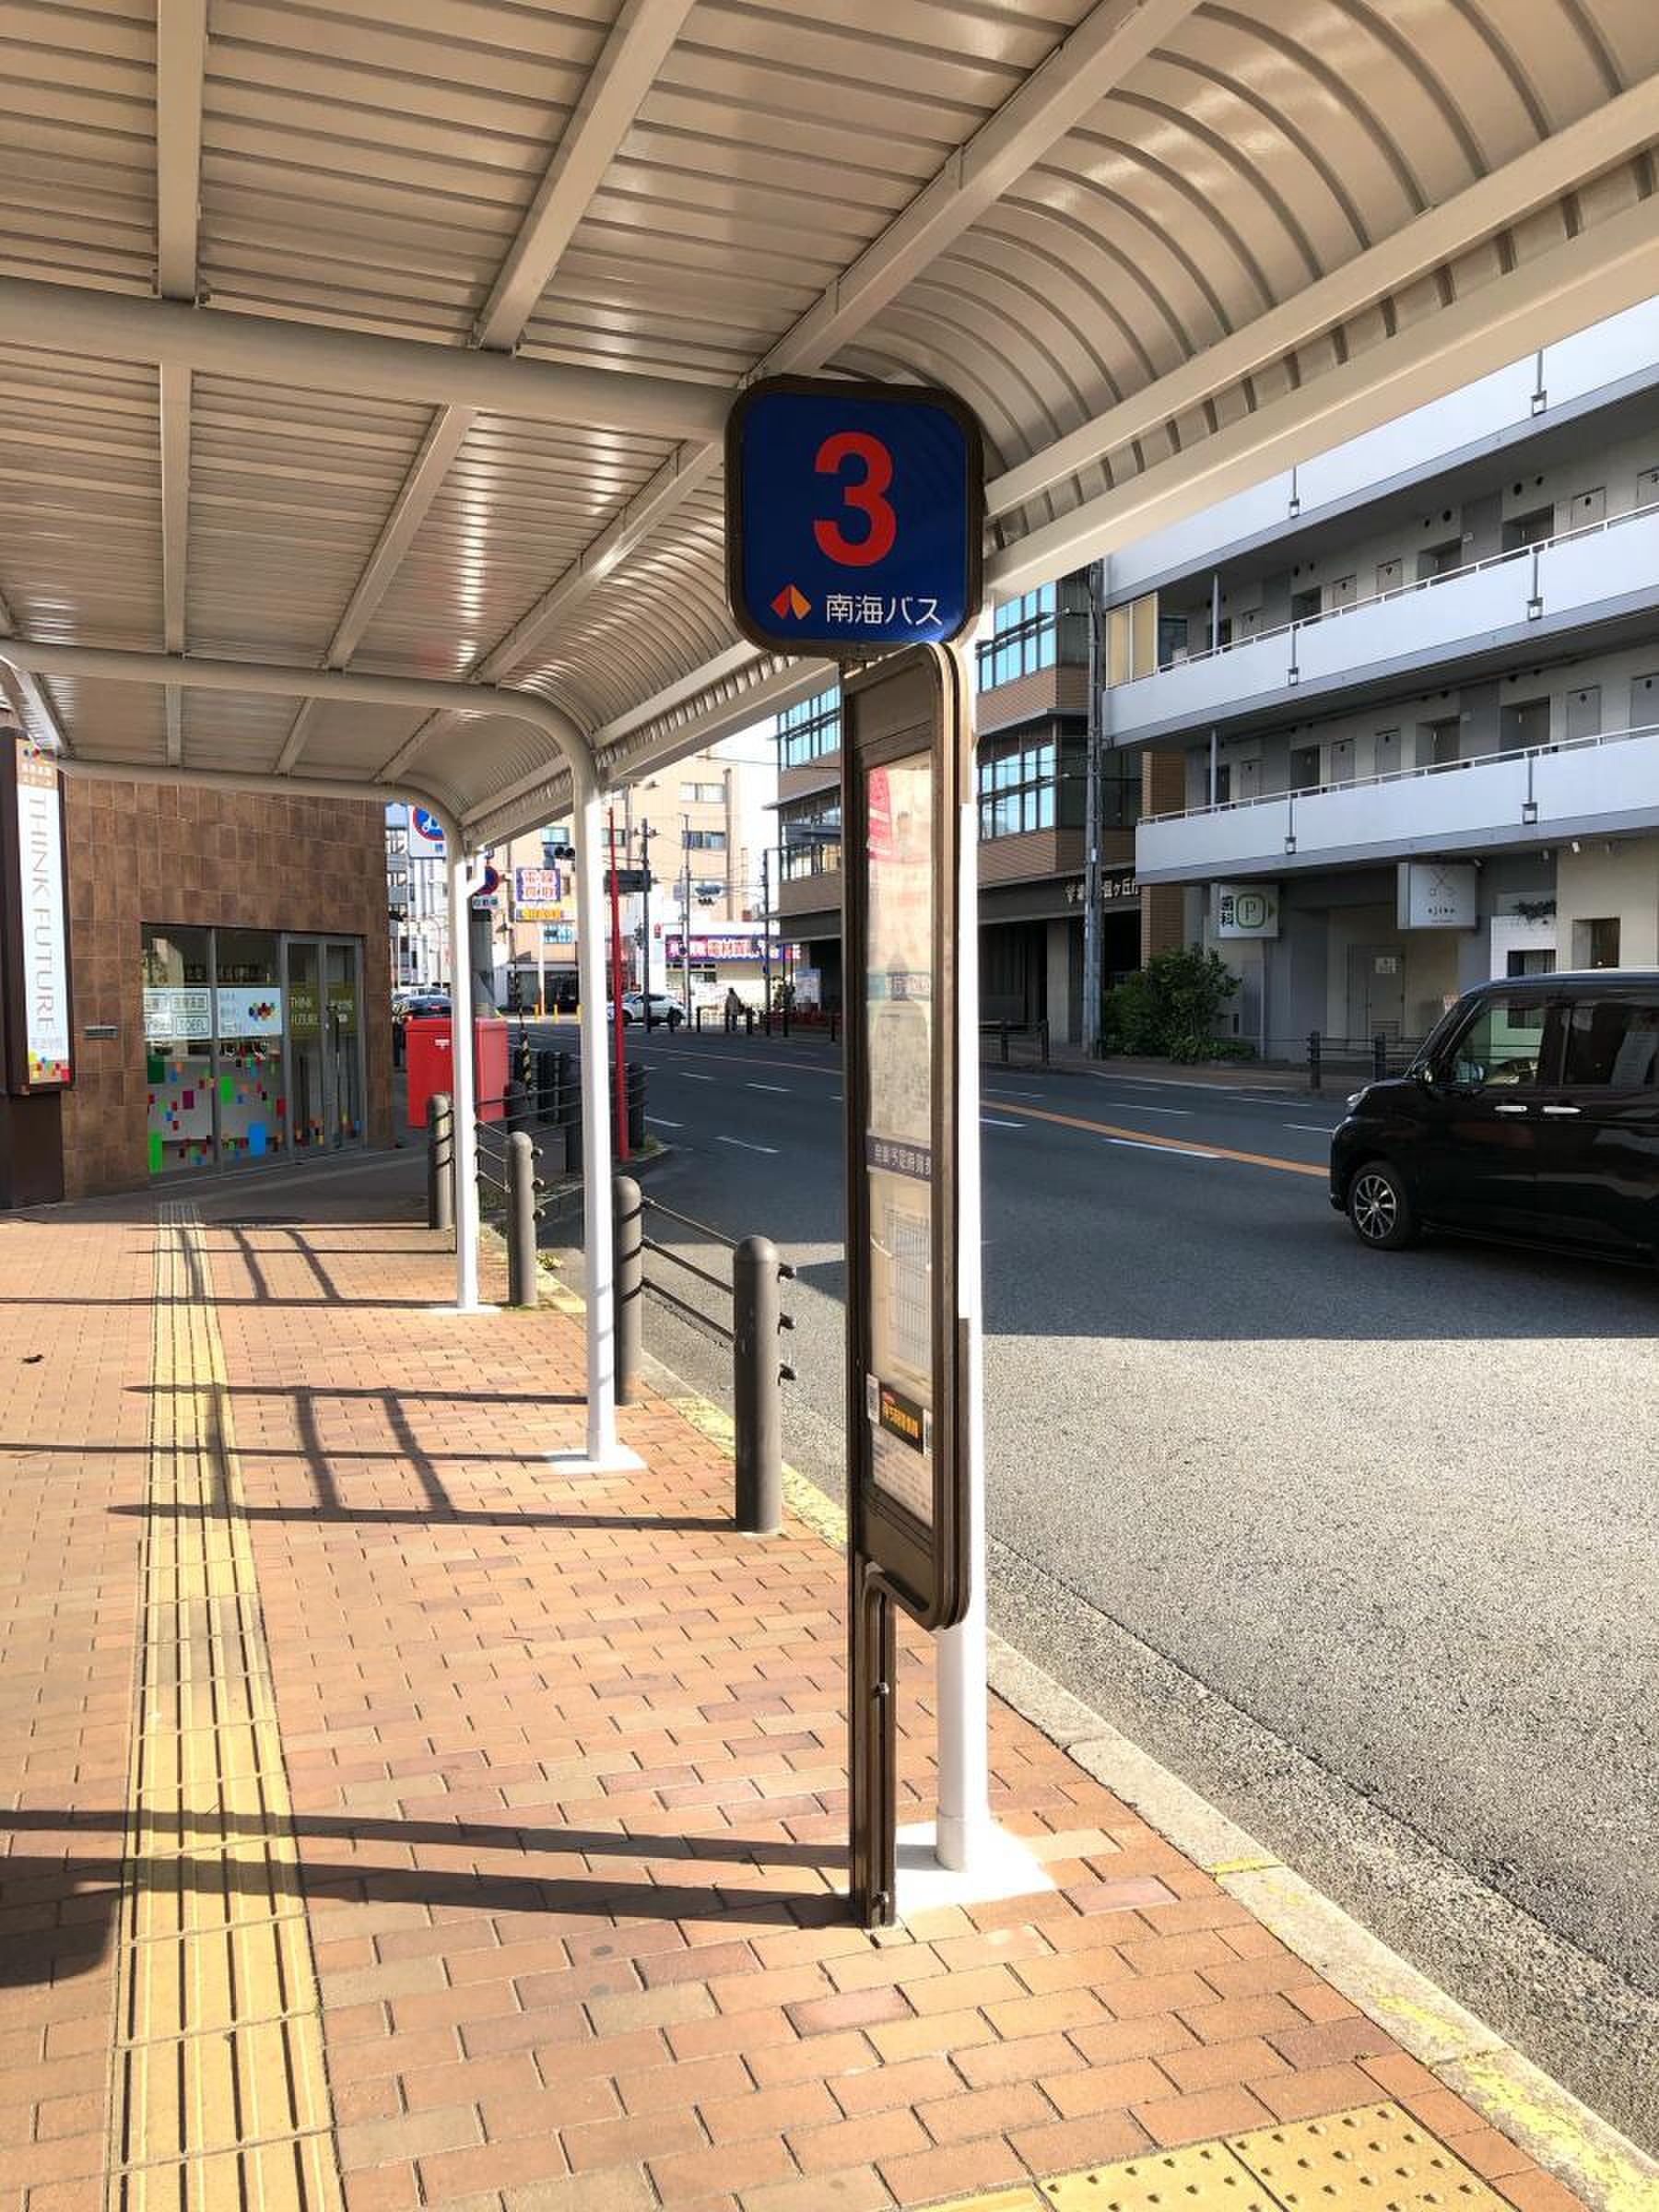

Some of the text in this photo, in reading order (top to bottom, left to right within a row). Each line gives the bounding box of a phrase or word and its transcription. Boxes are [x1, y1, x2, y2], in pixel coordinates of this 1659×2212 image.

[814, 431, 898, 567] 3
[826, 594, 943, 626] 南海バス
[29, 794, 52, 899] THINK
[1221, 895, 1234, 928] 歯科
[1245, 900, 1256, 921] P
[33, 908, 55, 1033] FUTURE
